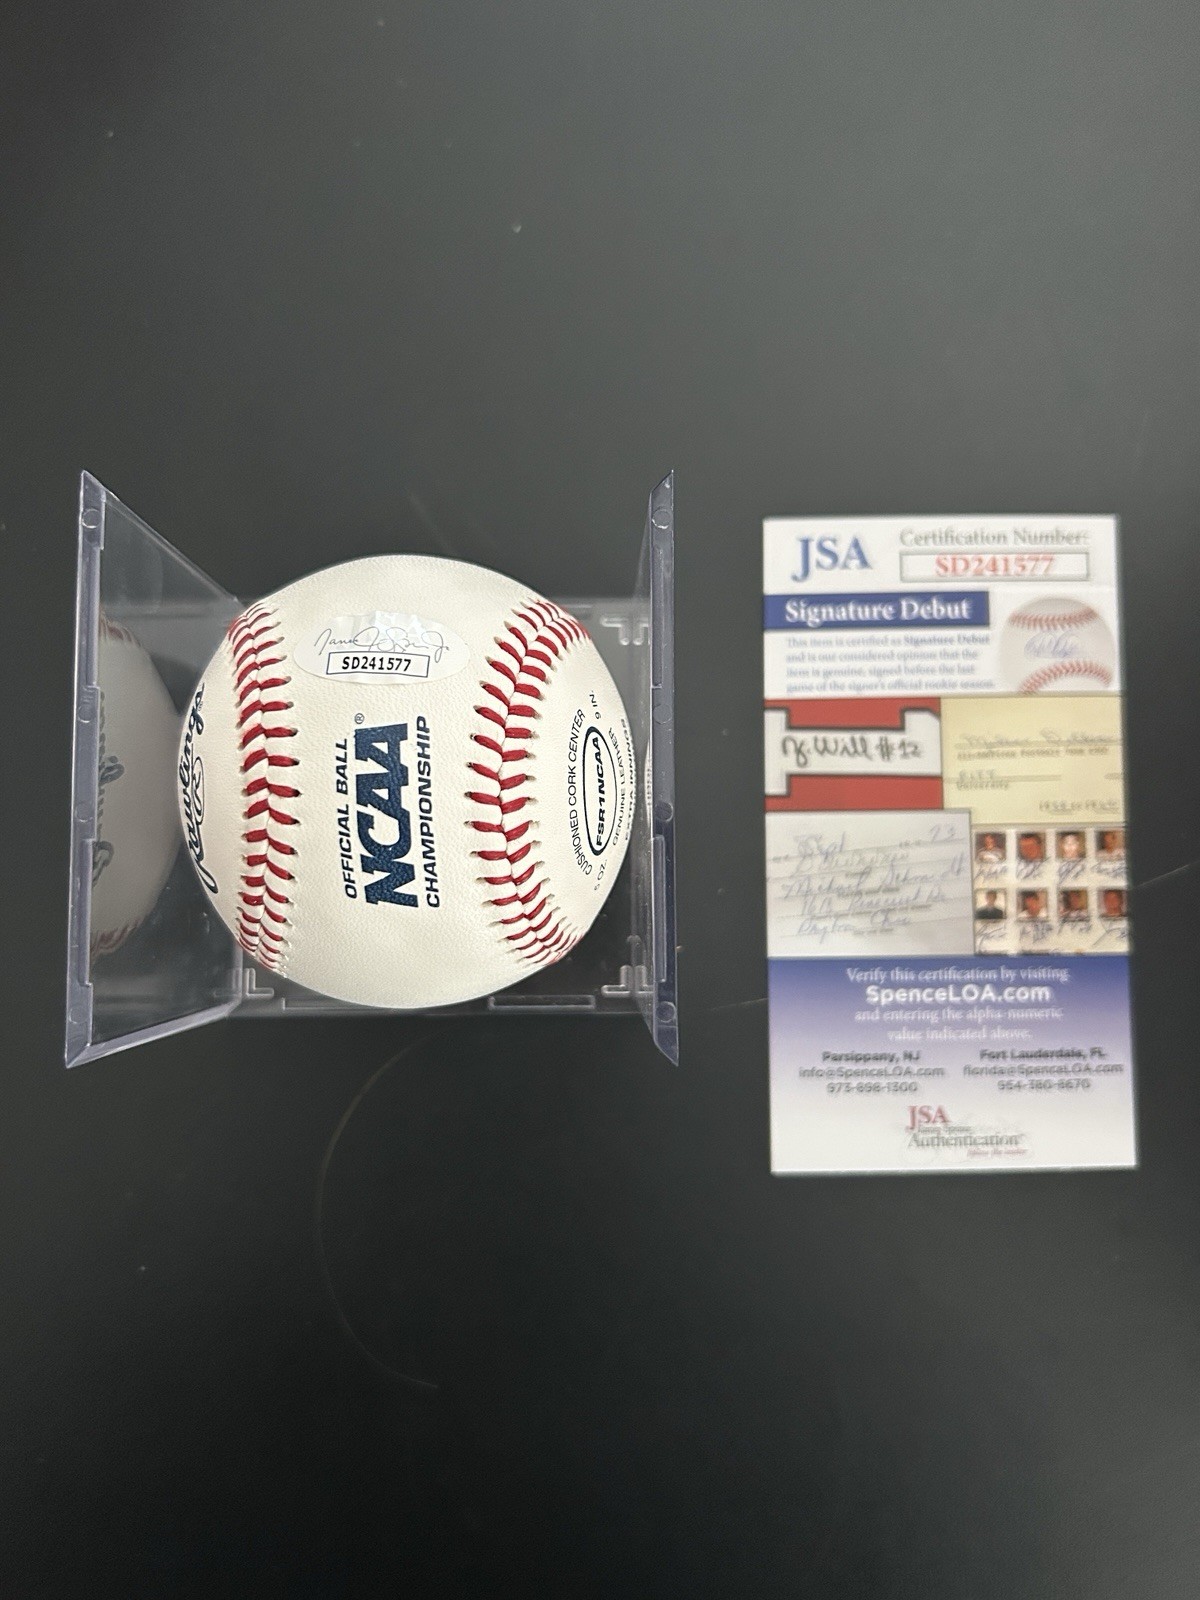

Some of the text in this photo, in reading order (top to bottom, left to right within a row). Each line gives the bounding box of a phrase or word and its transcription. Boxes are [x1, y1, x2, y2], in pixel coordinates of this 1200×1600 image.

[900, 528, 1007, 546] Certification
[791, 537, 874, 582] JSA
[935, 553, 1055, 576] SD241577
[785, 599, 970, 626] Signature Debut
[341, 656, 411, 671] SD241577
[568, 709, 593, 875] CUSHIONED CORK CENTER
[592, 737, 605, 846] FSR1NCAA
[608, 727, 626, 845] GENUINE LEATHER
[336, 738, 358, 899] OFFICIAL BALL
[354, 723, 419, 908] NCAA
[416, 716, 440, 908] CHAMPIONSHIP
[846, 966, 1070, 984] Verify this certification by visiting
[865, 984, 1053, 1005] SpenceLOA.com
[854, 1007, 880, 1021] and
[883, 1008, 939, 1023] entering
[941, 1006, 963, 1020] the
[888, 1026, 922, 1039] value
[926, 1025, 986, 1039] indicated
[822, 1050, 920, 1063] Parsippany, NJ
[979, 1049, 1007, 1060] Fort
[905, 1105, 951, 1133] JSA
[907, 1132, 1021, 1148] Authentication
